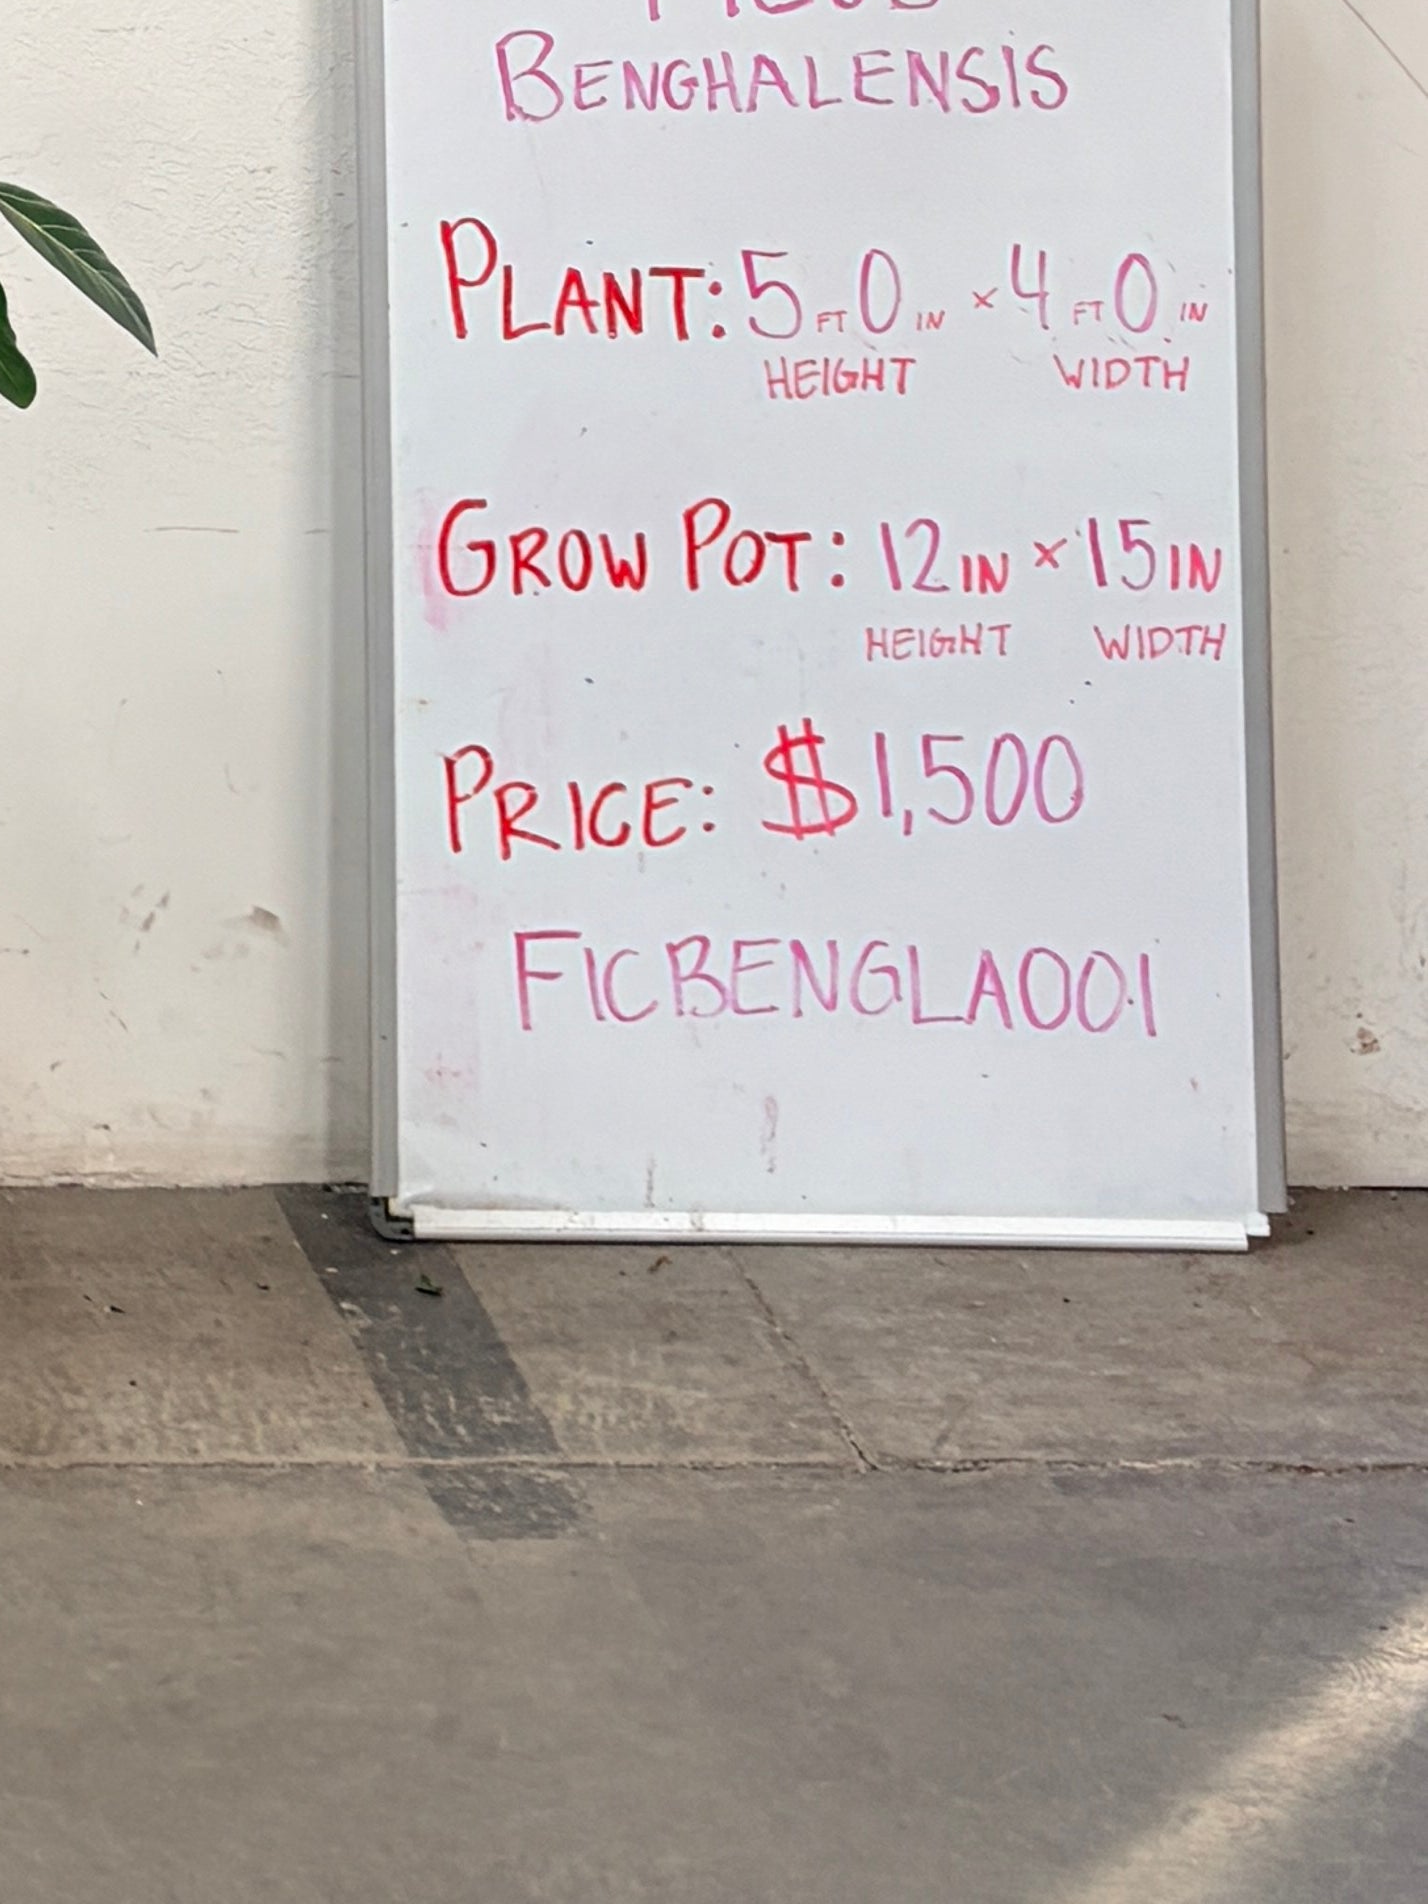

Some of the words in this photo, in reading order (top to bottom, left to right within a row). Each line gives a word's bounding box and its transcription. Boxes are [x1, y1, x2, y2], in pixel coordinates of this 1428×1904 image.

[494, 30, 1068, 124] BENGHALENSIS
[438, 217, 726, 343] PLANT:
[764, 356, 916, 400] HEIGHT
[1053, 354, 1190, 392] WIDTH
[433, 498, 649, 600] GROW
[681, 496, 845, 594] POT:
[864, 624, 1010, 661] HEIGHT
[1093, 624, 1227, 661] WIDTH
[442, 744, 715, 862] PRICE:
[760, 716, 1085, 842] $1,500
[513, 929, 1156, 1038] FICBENGLA001
